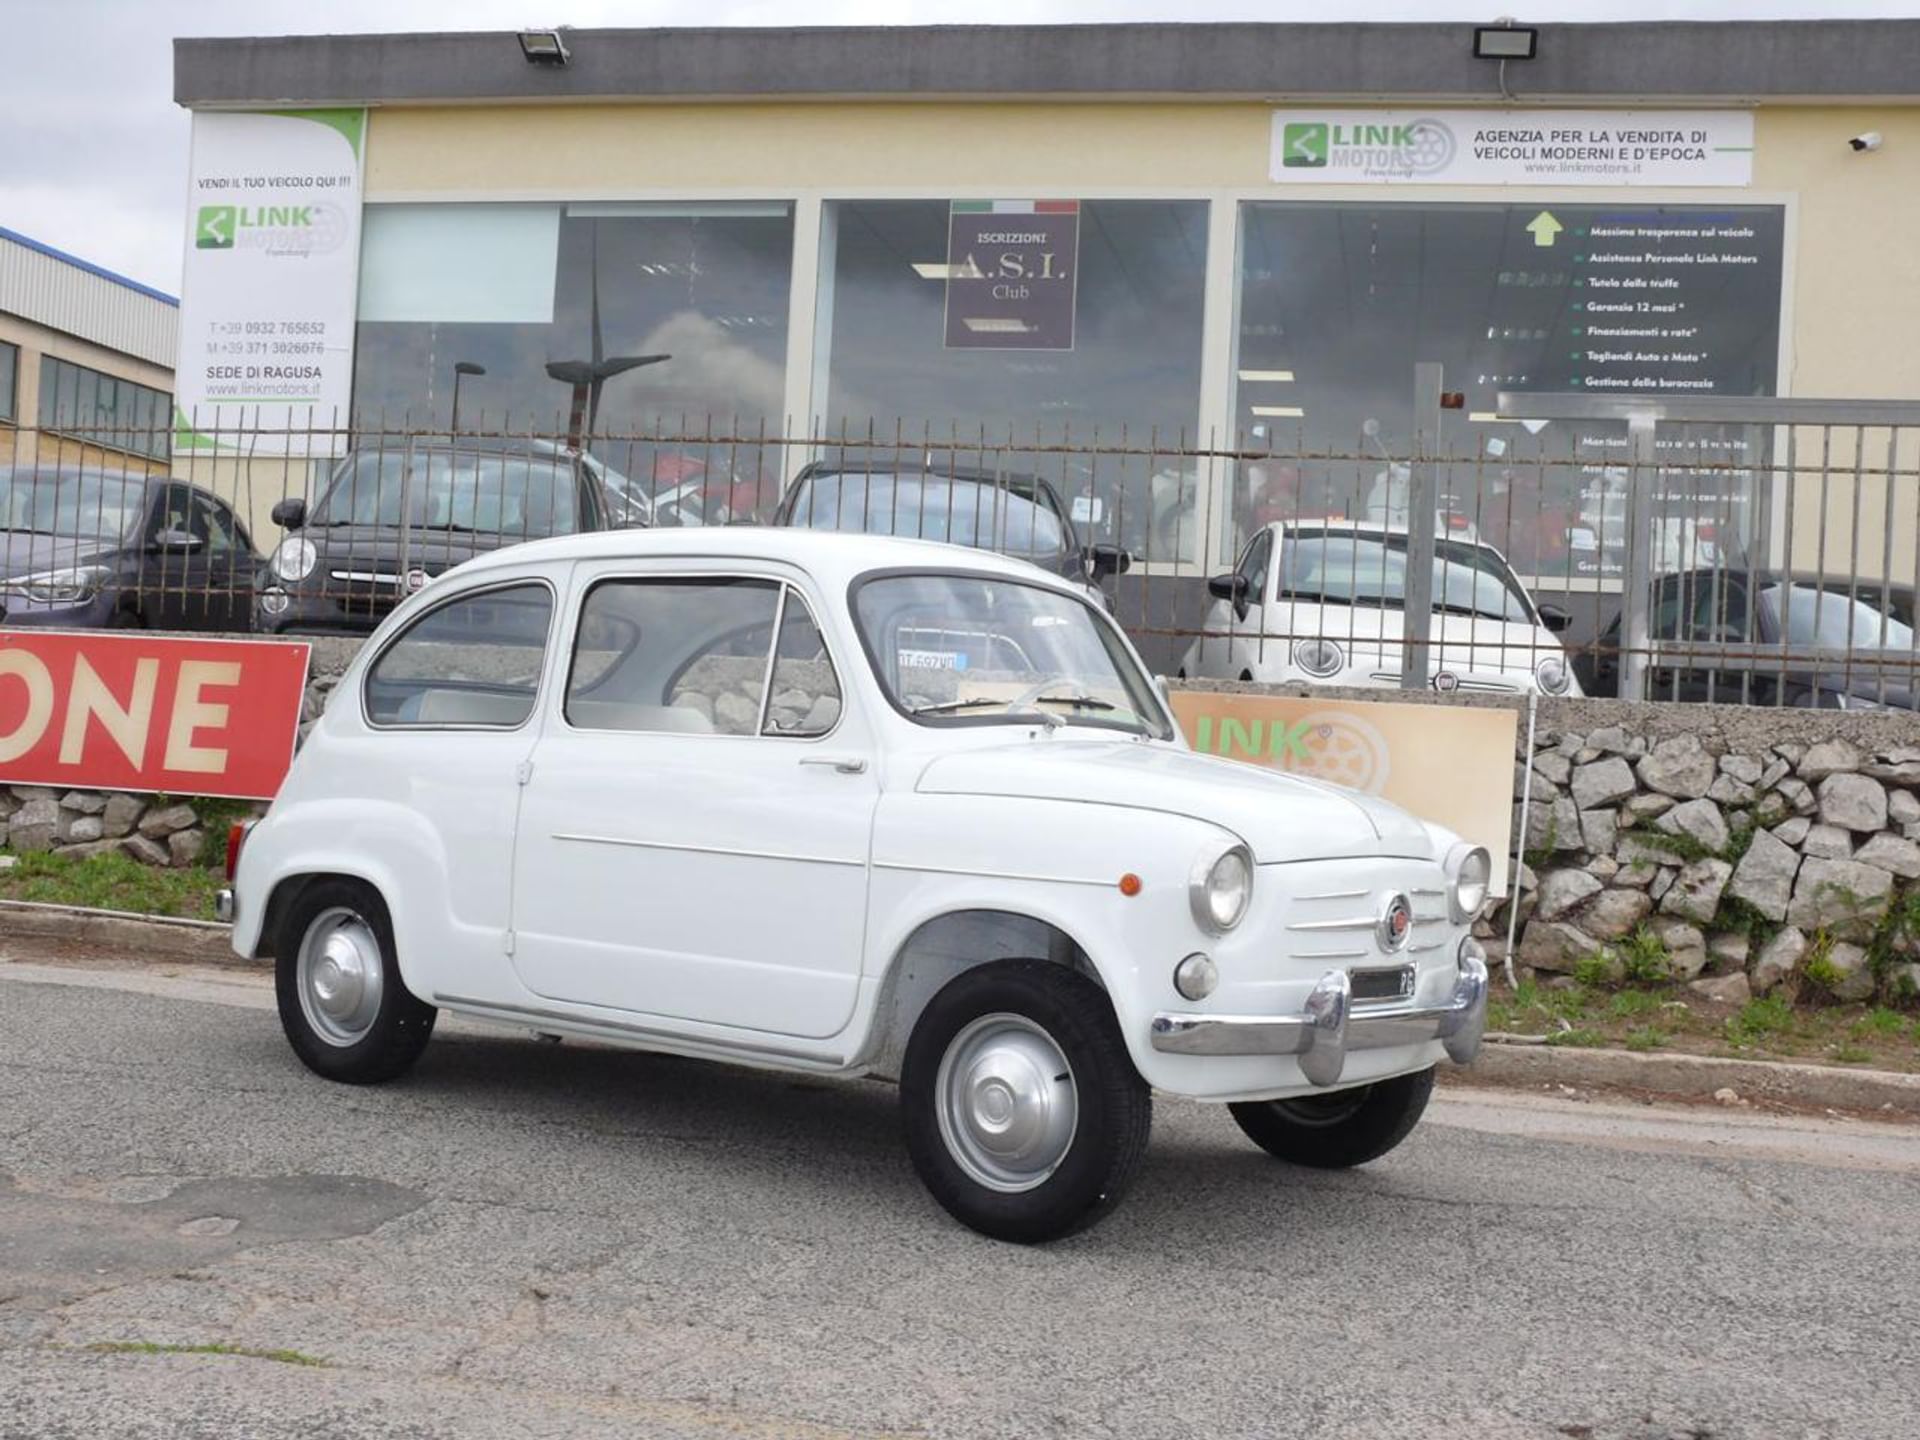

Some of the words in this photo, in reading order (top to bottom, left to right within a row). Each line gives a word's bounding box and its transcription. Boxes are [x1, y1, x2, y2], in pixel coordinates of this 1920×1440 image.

[1333, 125, 1414, 145] LINK
[1474, 130, 1543, 143] AGENZIA
[1550, 130, 1582, 143] PER
[1589, 130, 1610, 143] LA
[1616, 131, 1684, 143] VENDITA
[1691, 131, 1707, 143] DI
[1332, 149, 1416, 167] MOTORS
[1474, 147, 1535, 160] VEICOLI
[1540, 147, 1614, 160] MODERNI
[1619, 147, 1628, 160] E
[1634, 147, 1705, 160] D'EPOCA
[1525, 162, 1641, 174] www.linkmotors.it
[198, 178, 230, 189] VENDI
[232, 178, 240, 188] IL
[244, 177, 265, 188] TUO
[268, 176, 313, 188] VEICOLO
[316, 176, 336, 188] QUI
[240, 206, 313, 227] LINK
[978, 233, 1047, 243] ISCRIZIONI
[1701, 228, 1715, 237] sul
[1589, 253, 1642, 263] Assistenza
[1697, 254, 1718, 264] Link
[1720, 255, 1758, 264] Motors
[957, 252, 1066, 279] A.S.I.
[992, 285, 1030, 299] Club
[1587, 302, 1634, 312] Garanzia
[1637, 302, 1649, 312] 12
[1652, 303, 1676, 312] mesi
[245, 322, 275, 334] 0932
[280, 322, 325, 334] 765652
[1587, 326, 1659, 337] Finanziamenti
[247, 343, 267, 354] 371
[1635, 352, 1660, 362] Auto
[1671, 353, 1699, 362] Moto
[206, 366, 242, 379] SEDE
[246, 366, 260, 379] DI
[264, 366, 322, 379] RAGUSA
[206, 382, 321, 395] www.linkmotors.it
[1585, 377, 1629, 387] Gestione
[1659, 377, 1714, 388] burocrazia
[1185, 716, 1312, 759] INK
